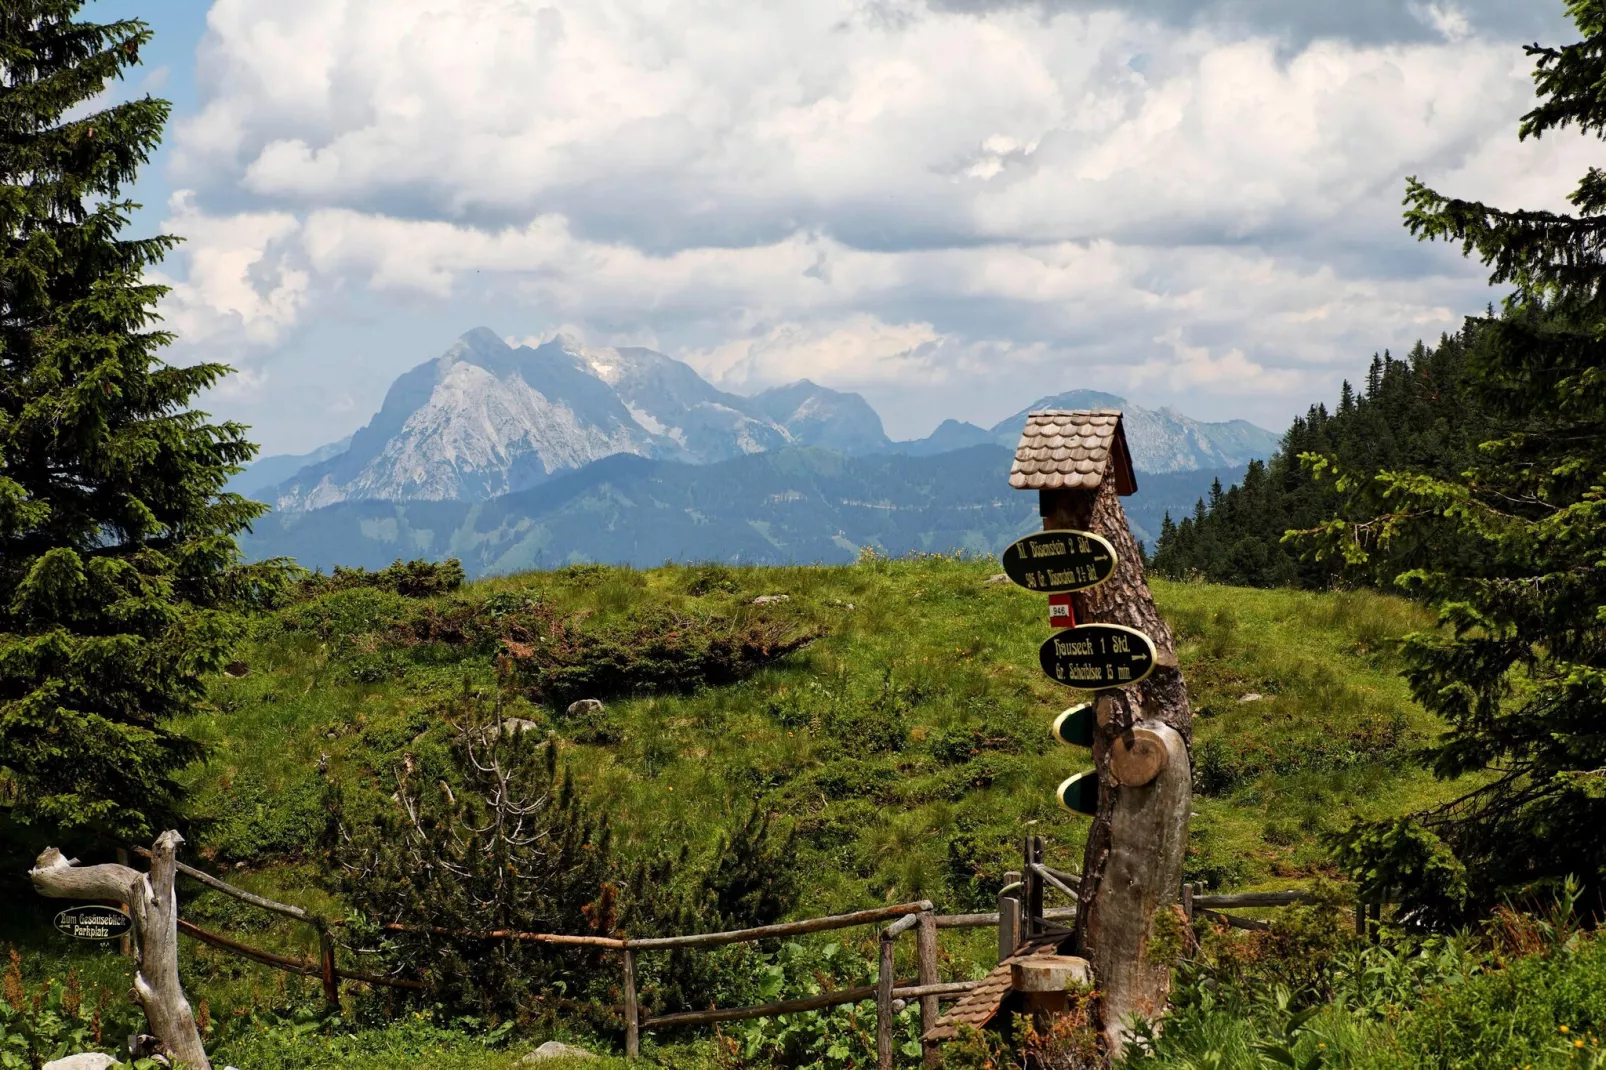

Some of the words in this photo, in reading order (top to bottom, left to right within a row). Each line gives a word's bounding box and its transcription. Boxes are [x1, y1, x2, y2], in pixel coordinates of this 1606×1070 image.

[1068, 538, 1075, 554] 2
[1052, 606, 1066, 615] 946
[1100, 637, 1106, 654] 1
[1112, 635, 1131, 653] Std.
[1055, 662, 1066, 680] Gr.
[1106, 663, 1114, 680] 15
[74, 924, 109, 938] Parkplatz
